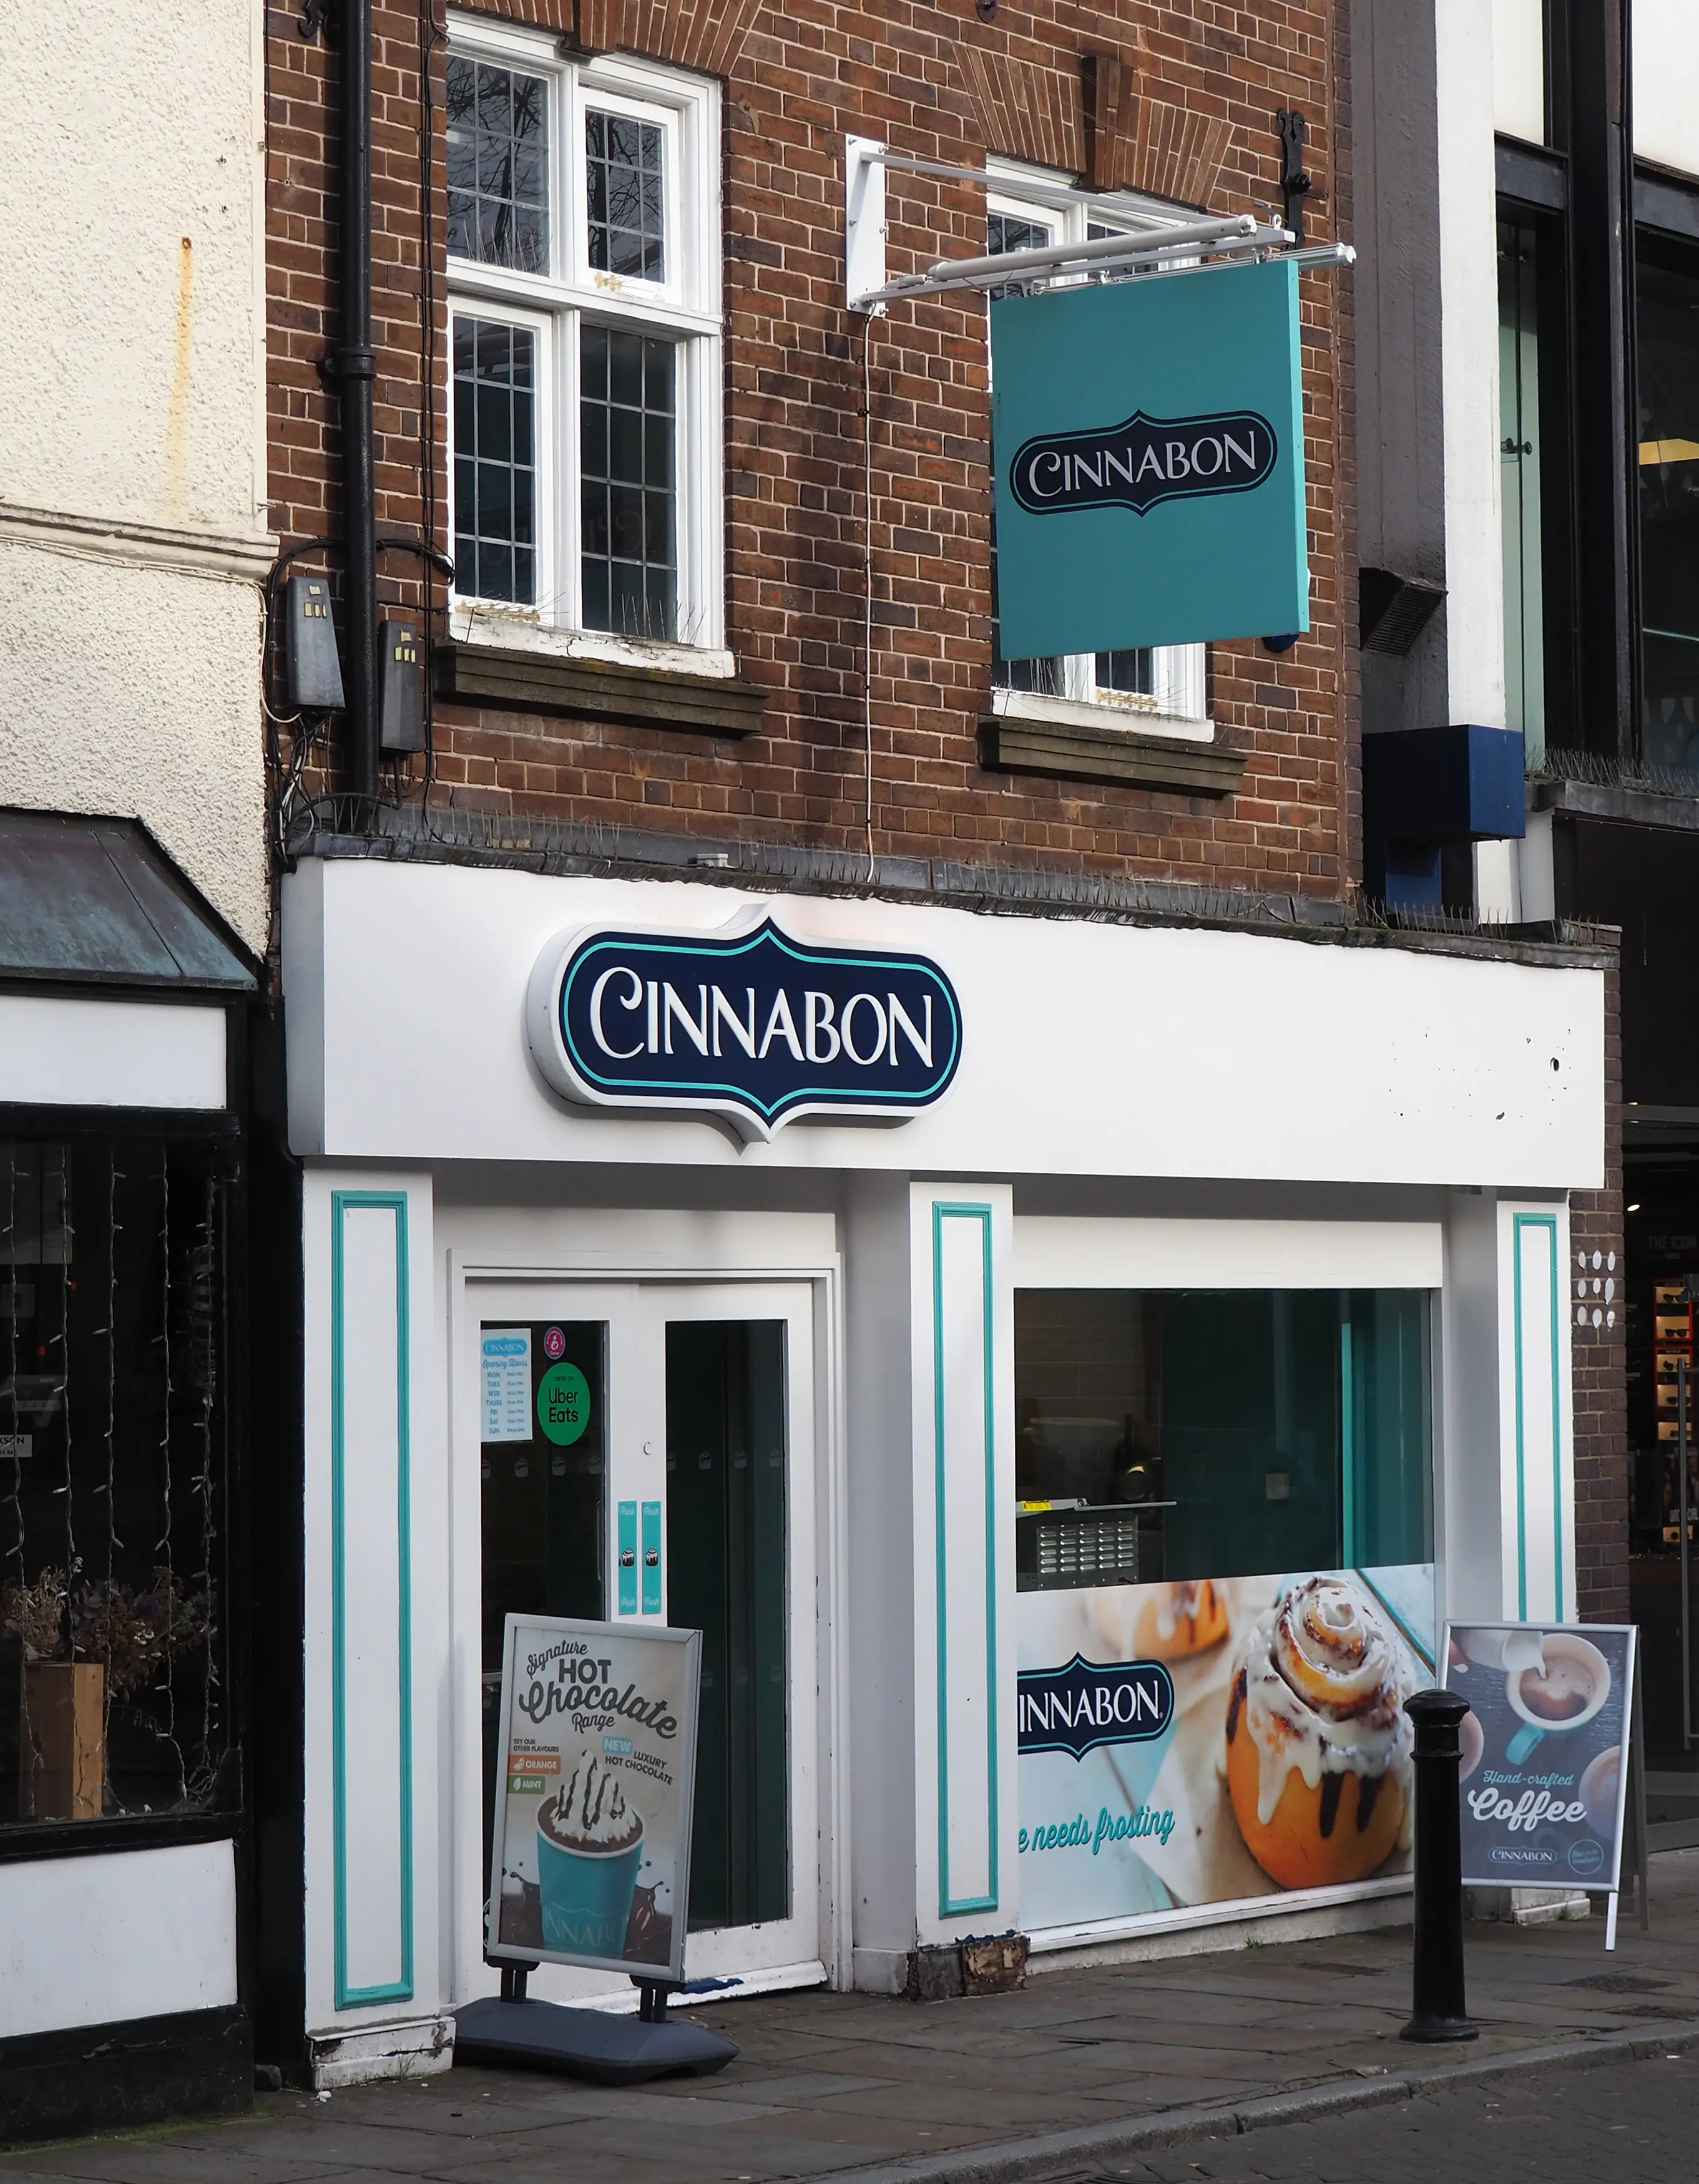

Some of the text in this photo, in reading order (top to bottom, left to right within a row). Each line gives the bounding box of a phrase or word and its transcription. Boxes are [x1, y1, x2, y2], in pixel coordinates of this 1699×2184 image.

[1029, 431, 1256, 497] CINNABON
[590, 967, 934, 1068] CINNABON
[1648, 1235, 1698, 1250] THE ICON
[549, 1388, 578, 1404] Uber
[549, 1407, 578, 1423] Eats
[527, 1639, 588, 1680] Signature
[559, 1659, 611, 1684] HOT
[519, 1680, 677, 1739] Chocolate
[1019, 1680, 1159, 1732] INNABON
[572, 1712, 615, 1734] Range
[604, 1738, 632, 1753] NEW
[526, 1760, 557, 1769] ORANGE
[605, 1755, 673, 1785] HOT CHOCOLATE
[634, 1750, 667, 1769] LUXURY
[522, 1780, 541, 1788] MINT
[1483, 1770, 1574, 1789] Hand-crafted
[1467, 1787, 1588, 1831] Coffee
[1032, 1813, 1092, 1851] needs
[1092, 1805, 1175, 1855] frosting
[1492, 1850, 1553, 1861] CINNABON
